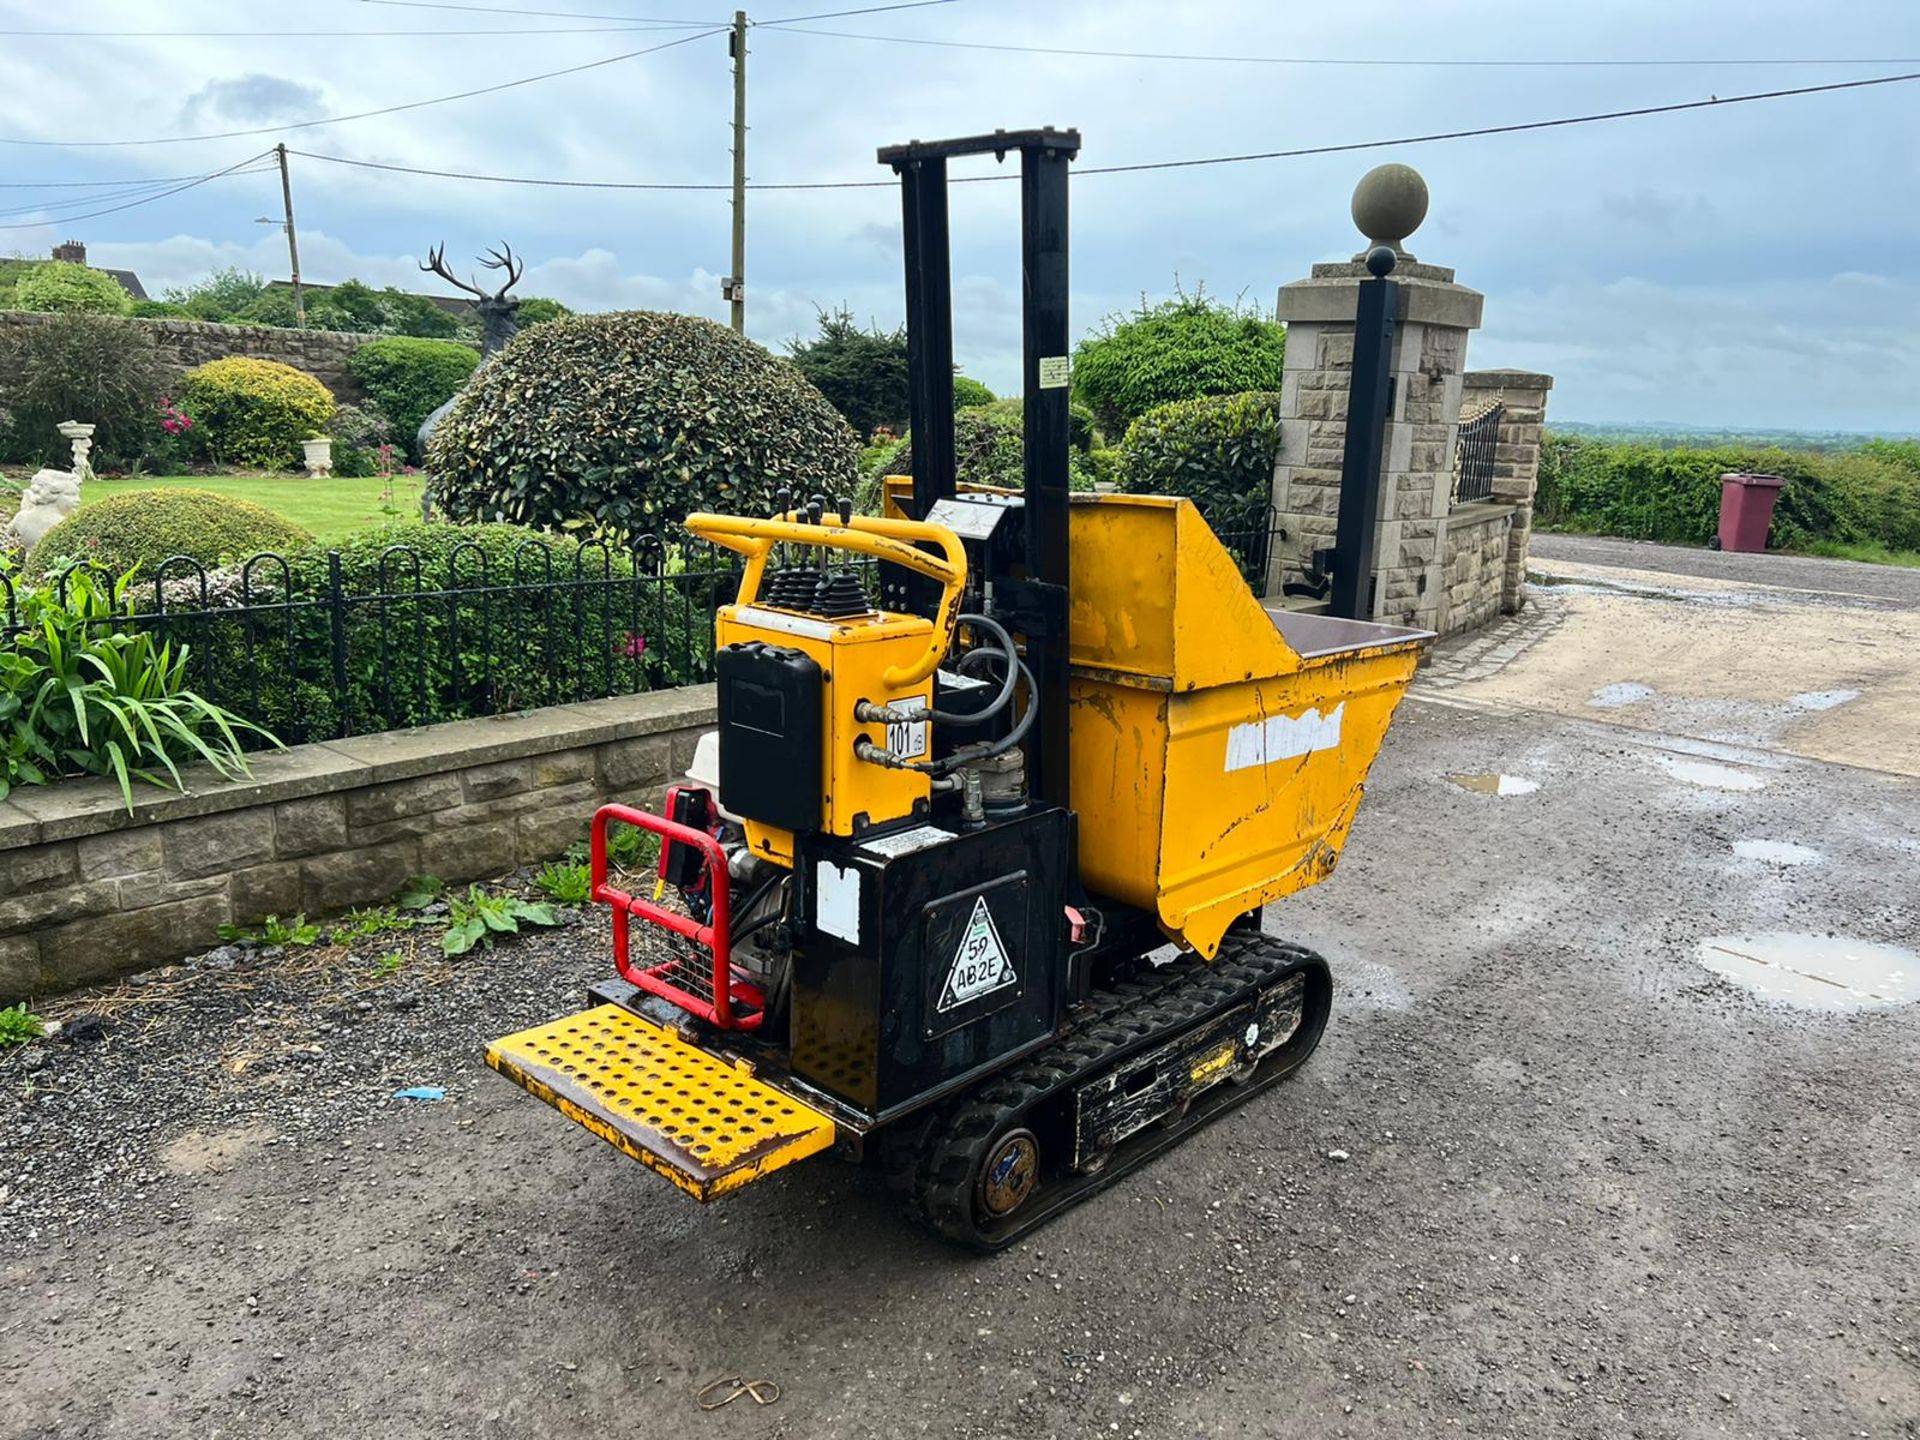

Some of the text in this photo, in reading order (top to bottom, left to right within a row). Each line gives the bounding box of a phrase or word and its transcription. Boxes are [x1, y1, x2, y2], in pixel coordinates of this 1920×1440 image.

[890, 723, 910, 755] 101
[968, 936, 988, 960] 59
[957, 956, 998, 991] AB2E
